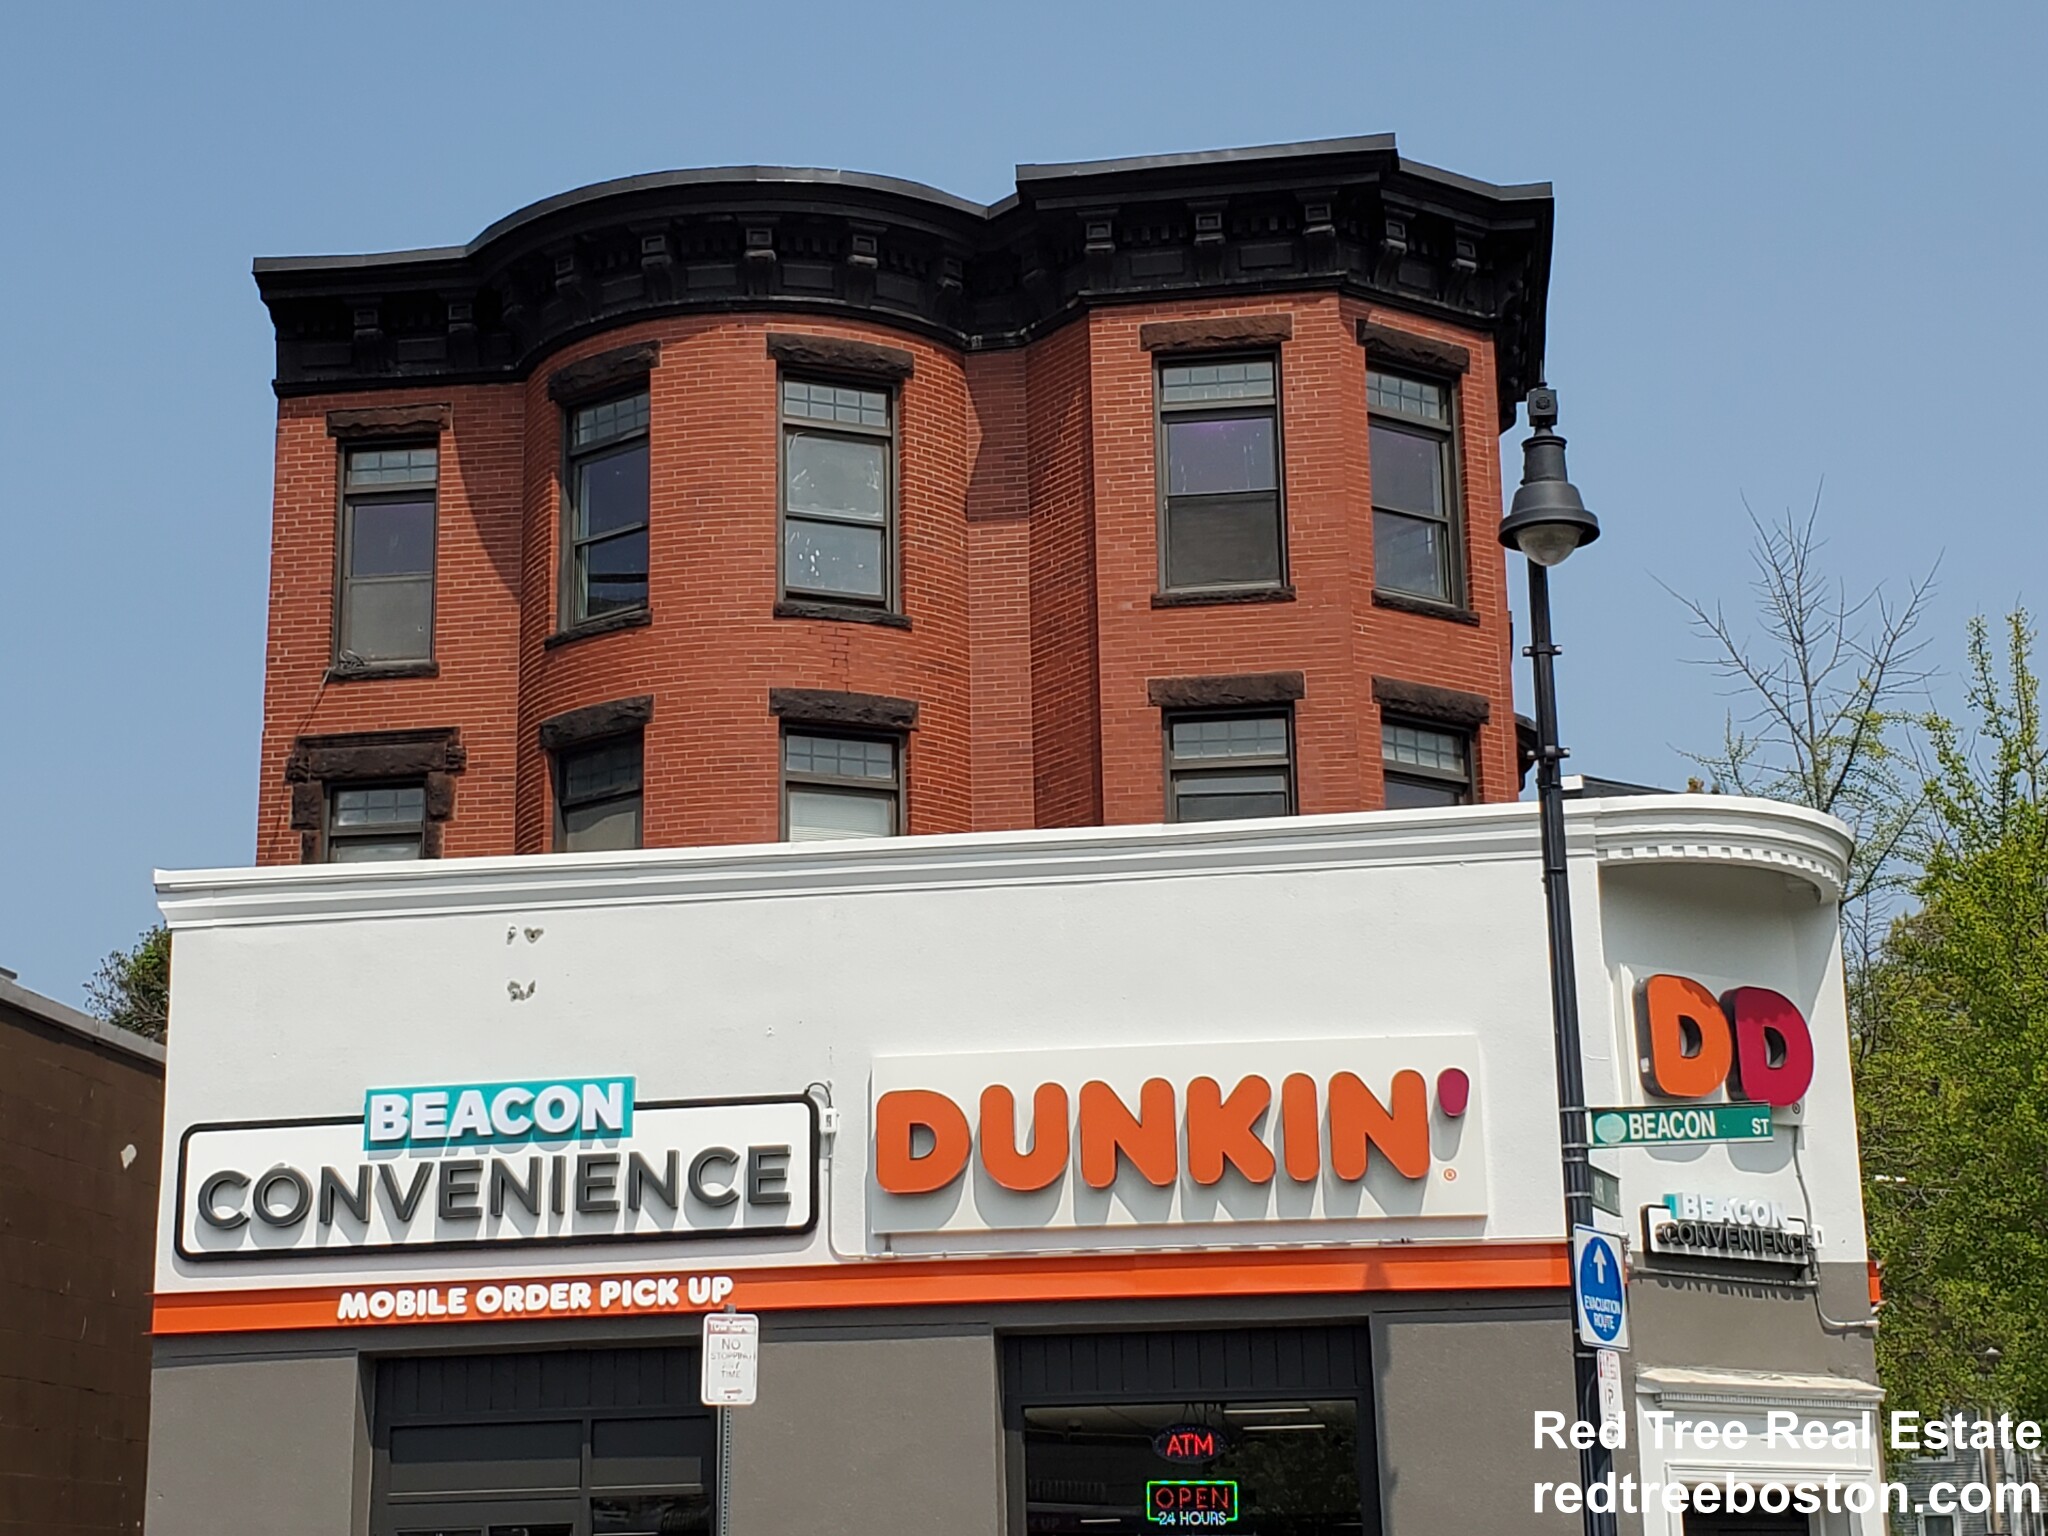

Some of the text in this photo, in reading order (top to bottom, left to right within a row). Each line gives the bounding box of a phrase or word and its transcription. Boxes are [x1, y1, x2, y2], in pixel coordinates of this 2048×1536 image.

[369, 1082, 624, 1143] BEACON
[1628, 1110, 1770, 1140] BEACON ST
[875, 1066, 1470, 1194] DUNKIN'
[199, 1144, 792, 1230] CONVENIENCE
[1677, 1192, 1790, 1230] BEACON
[1656, 1221, 1817, 1256] CONVENIENCE
[337, 1276, 734, 1320] MOBILE ORDER PICK UP
[1584, 1294, 1621, 1315] EVACUATION
[1593, 1312, 1616, 1331] ROUTE
[721, 1338, 741, 1351] NO
[720, 1369, 742, 1379] TIME
[1166, 1432, 1215, 1457] ATM
[1155, 1486, 1230, 1510] OPEN
[1158, 1511, 1228, 1526] 24 HOURS
